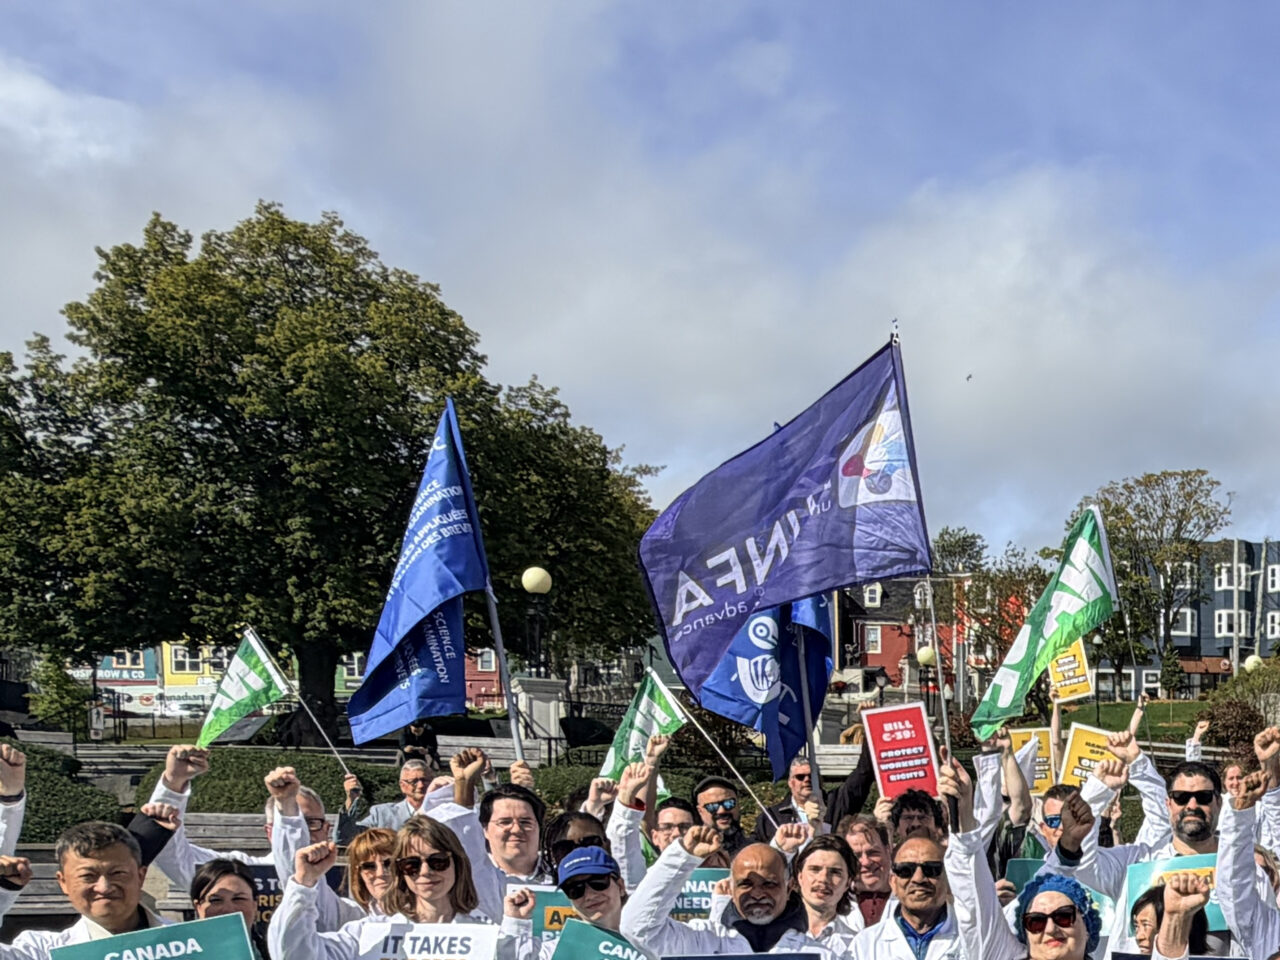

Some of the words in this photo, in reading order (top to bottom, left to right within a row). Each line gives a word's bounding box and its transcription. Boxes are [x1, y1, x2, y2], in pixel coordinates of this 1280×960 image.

[421, 530, 442, 550] DES
[440, 523, 473, 538] BREV
[433, 612, 456, 660] SCIENCE
[423, 622, 450, 684] AMINATION
[883, 720, 913, 732] BILL
[882, 730, 916, 742] C-39:
[880, 746, 924, 758] PROTECT
[889, 770, 926, 781] RIGHTS
[673, 897, 712, 909] NEED
[382, 935, 403, 954] IT
[409, 936, 472, 955] TAKES
